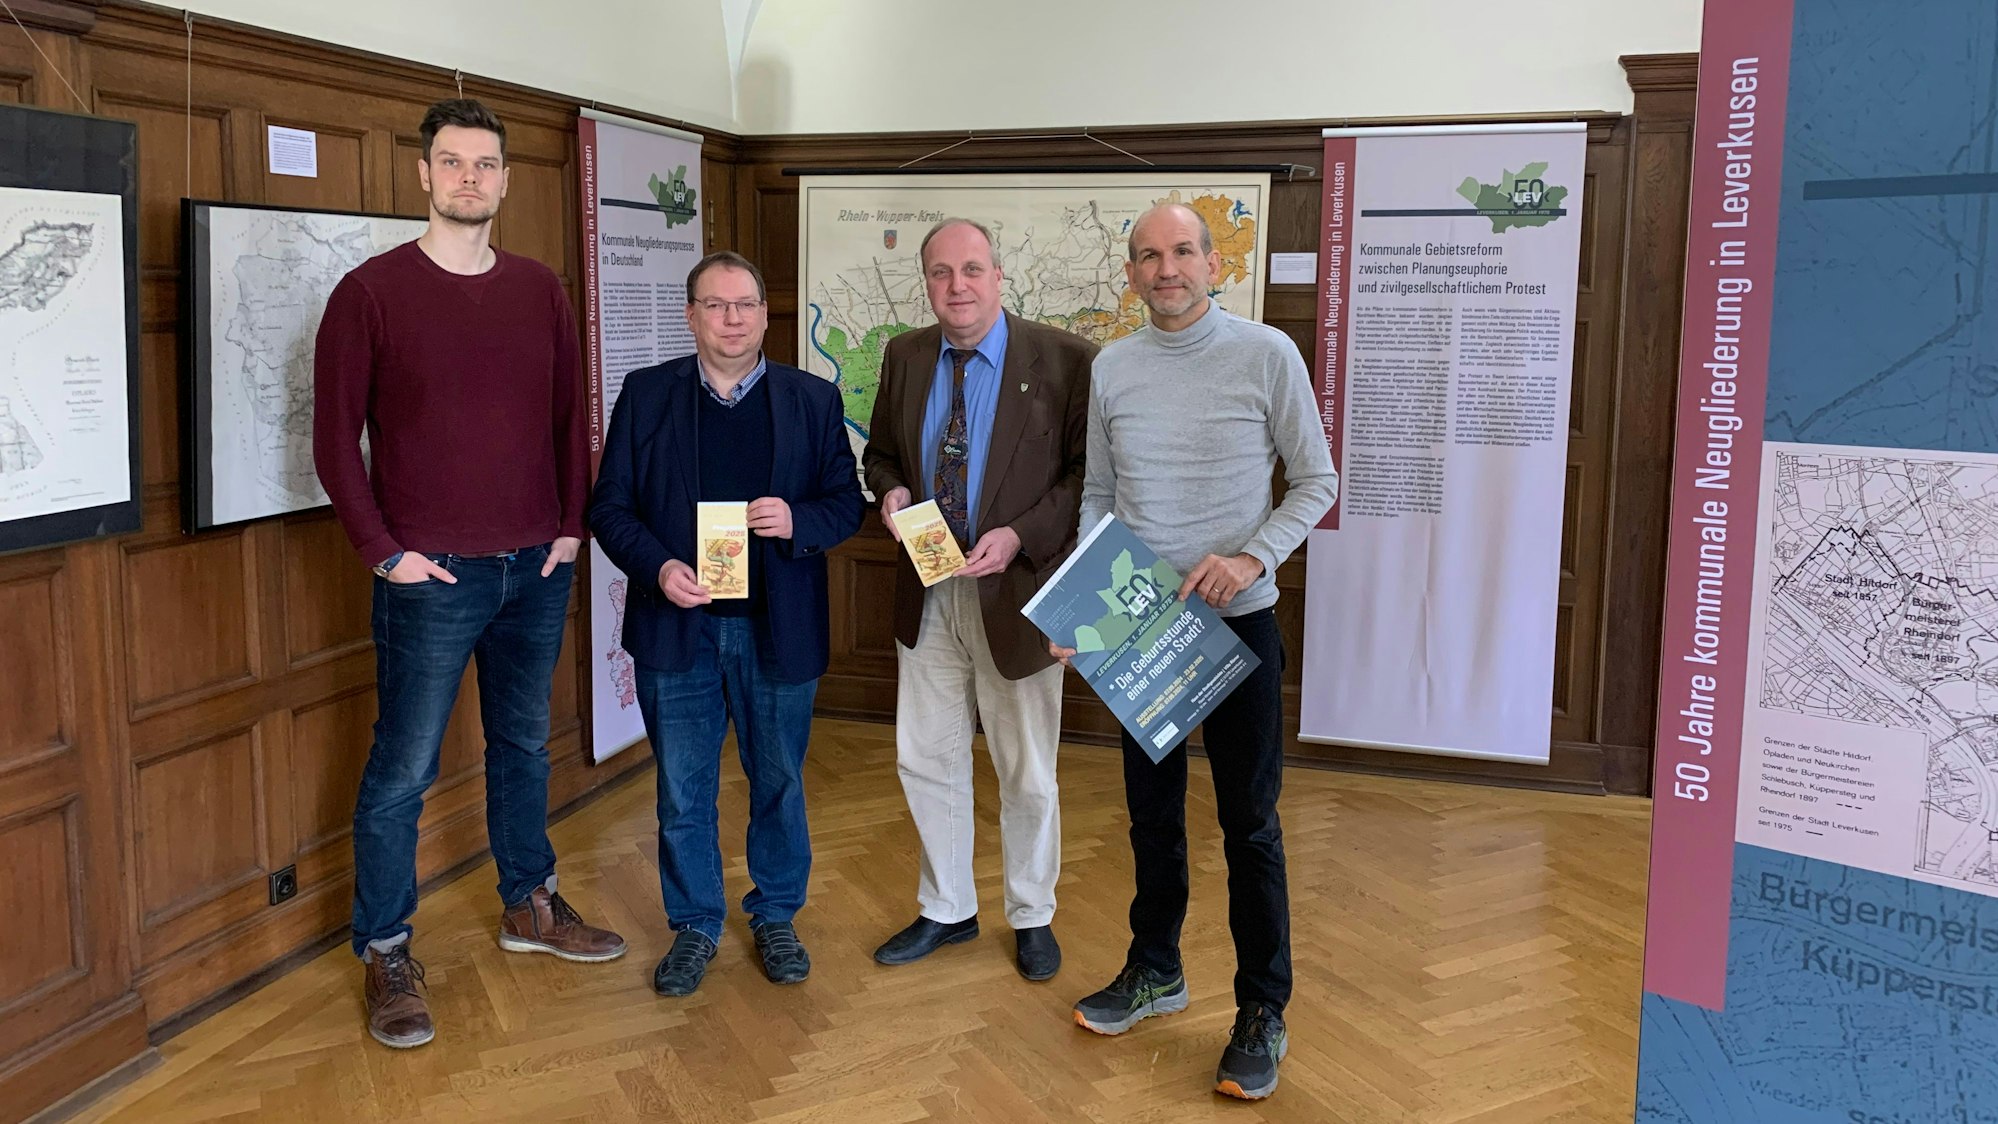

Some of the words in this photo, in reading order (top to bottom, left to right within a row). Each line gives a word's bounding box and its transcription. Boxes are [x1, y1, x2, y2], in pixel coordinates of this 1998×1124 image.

[1712, 56, 1760, 229] Leverkusen
[584, 145, 594, 214] Leverkusen
[1329, 162, 1345, 226] Leverkusen
[1514, 192, 1542, 203] LEV
[586, 219, 594, 230] in
[1328, 231, 1342, 242] in
[602, 233, 634, 247] Kommunale
[1360, 242, 1421, 257] Kommunale
[1425, 243, 1503, 257] Gebietsreform
[1709, 240, 1747, 267] in
[603, 252, 608, 264] in
[611, 253, 643, 266] Deutschland
[1358, 263, 1409, 275] zwischen
[1412, 262, 1508, 278] Planungseuphorie
[586, 234, 596, 321] Neugliederung
[1325, 246, 1345, 327] Neugliederung
[1358, 282, 1378, 294] und
[1380, 282, 1502, 296] zivilgesellschaftlichem
[1506, 282, 1546, 296] Protest
[589, 326, 598, 393] kommunale
[1323, 331, 1337, 395] kommunale
[1694, 276, 1753, 490] Neugliederung
[590, 398, 598, 430] Jahre
[1320, 400, 1334, 431] Jahre
[590, 436, 600, 451] 50
[1684, 501, 1729, 666] kommunale
[1825, 574, 1853, 586] Stadt
[1860, 578, 1897, 589] Hitdorf
[1115, 573, 1162, 621] 50
[1126, 583, 1159, 616] LEV
[1855, 592, 1877, 601] 1857
[1096, 639, 1133, 677] LEVERKUSEN,
[1131, 633, 1139, 641] 1.
[1136, 610, 1160, 636] JANUAR
[1904, 628, 1960, 641] Rheindorf
[1114, 669, 1135, 690] Die
[1130, 608, 1195, 674] Geburtsstunde
[1124, 674, 1152, 701] einer
[1147, 649, 1178, 679] neuen
[1172, 617, 1207, 653] Stadt?
[1677, 675, 1715, 755] Jahre
[1914, 709, 1932, 725] RHEIN
[1764, 737, 1795, 747] Grenzen
[1814, 746, 1840, 756] Städte
[1763, 749, 1794, 760] Opladen
[1815, 759, 1860, 772] Neukirchen
[1763, 763, 1783, 771] sowie
[1675, 764, 1711, 802] 50
[1760, 786, 1796, 798] Rheindorf
[1799, 794, 1818, 803] 1897
[1762, 774, 1806, 789] Schlebusch,
[1759, 806, 1789, 818] Grenzen
[1808, 817, 1829, 826] Stadt
[1833, 821, 1879, 836] Leverkusen
[1774, 822, 1792, 831] 1975
